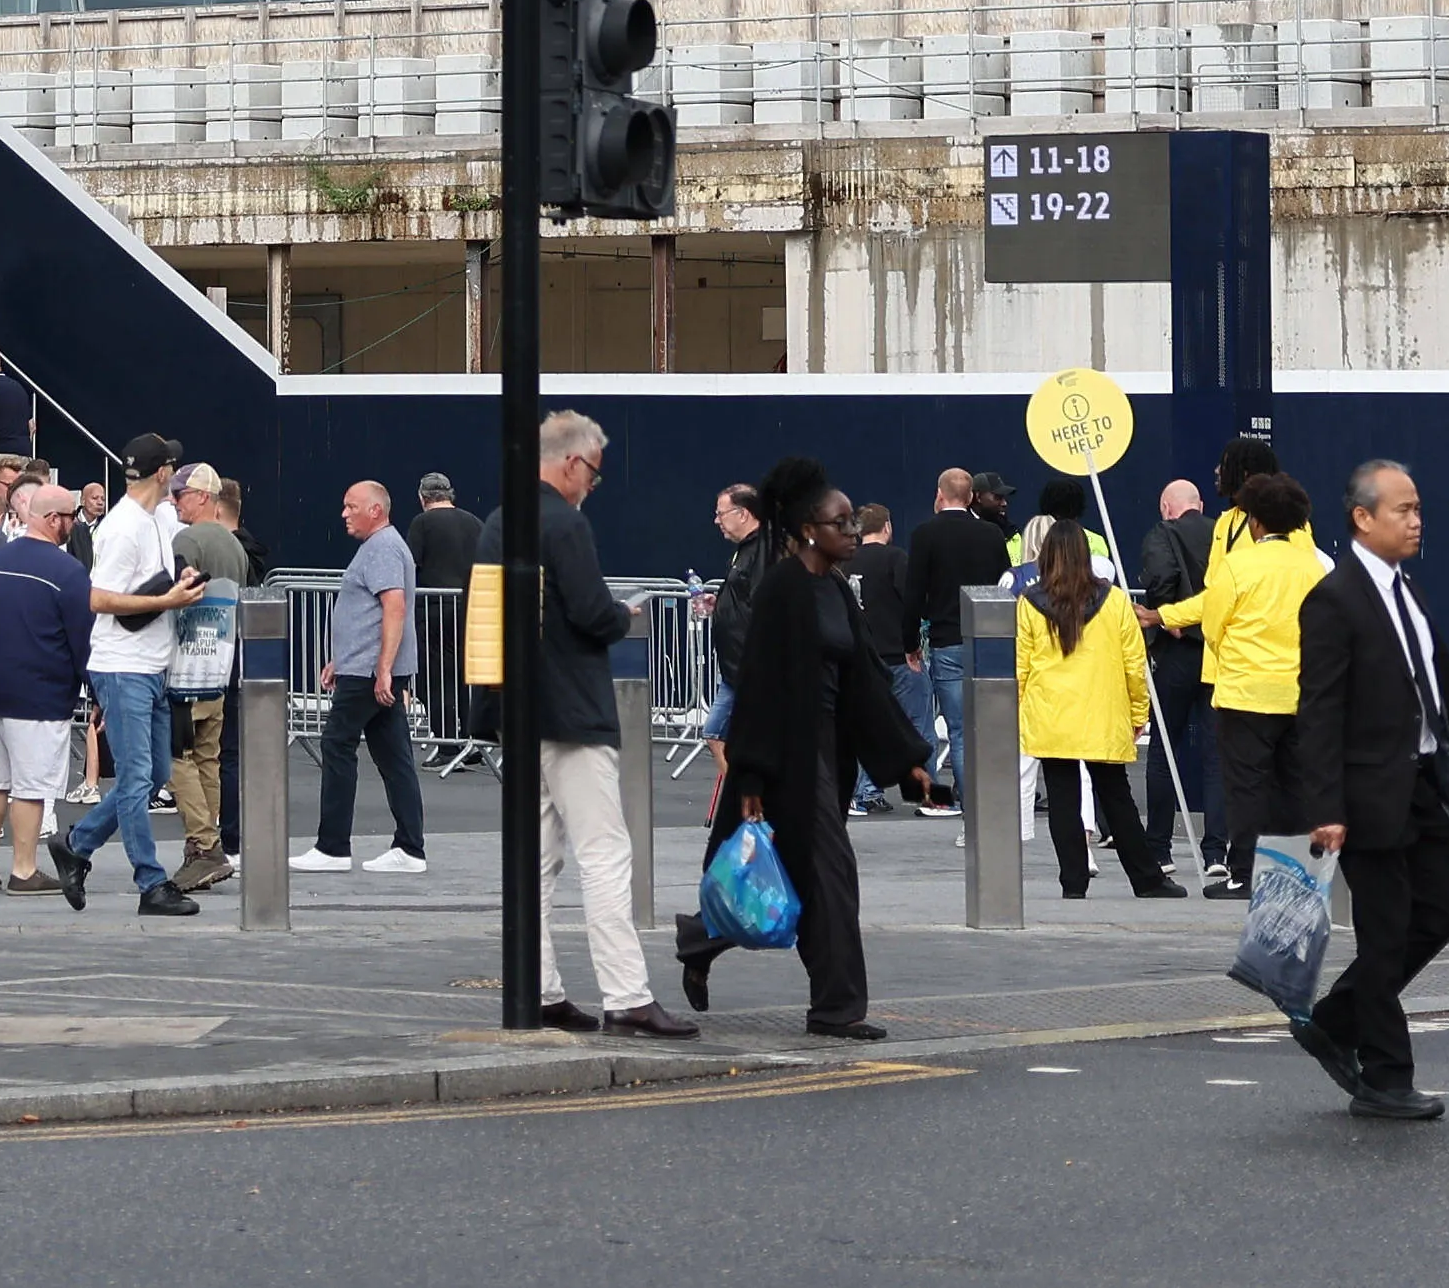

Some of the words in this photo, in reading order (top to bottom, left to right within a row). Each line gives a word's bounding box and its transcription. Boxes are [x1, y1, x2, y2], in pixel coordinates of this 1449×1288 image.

[1030, 145, 1111, 174] 11-18
[1030, 192, 1110, 220] 19-22
[1051, 422, 1089, 443] HERE
[1092, 416, 1112, 432] TO
[1068, 433, 1104, 455] HELP
